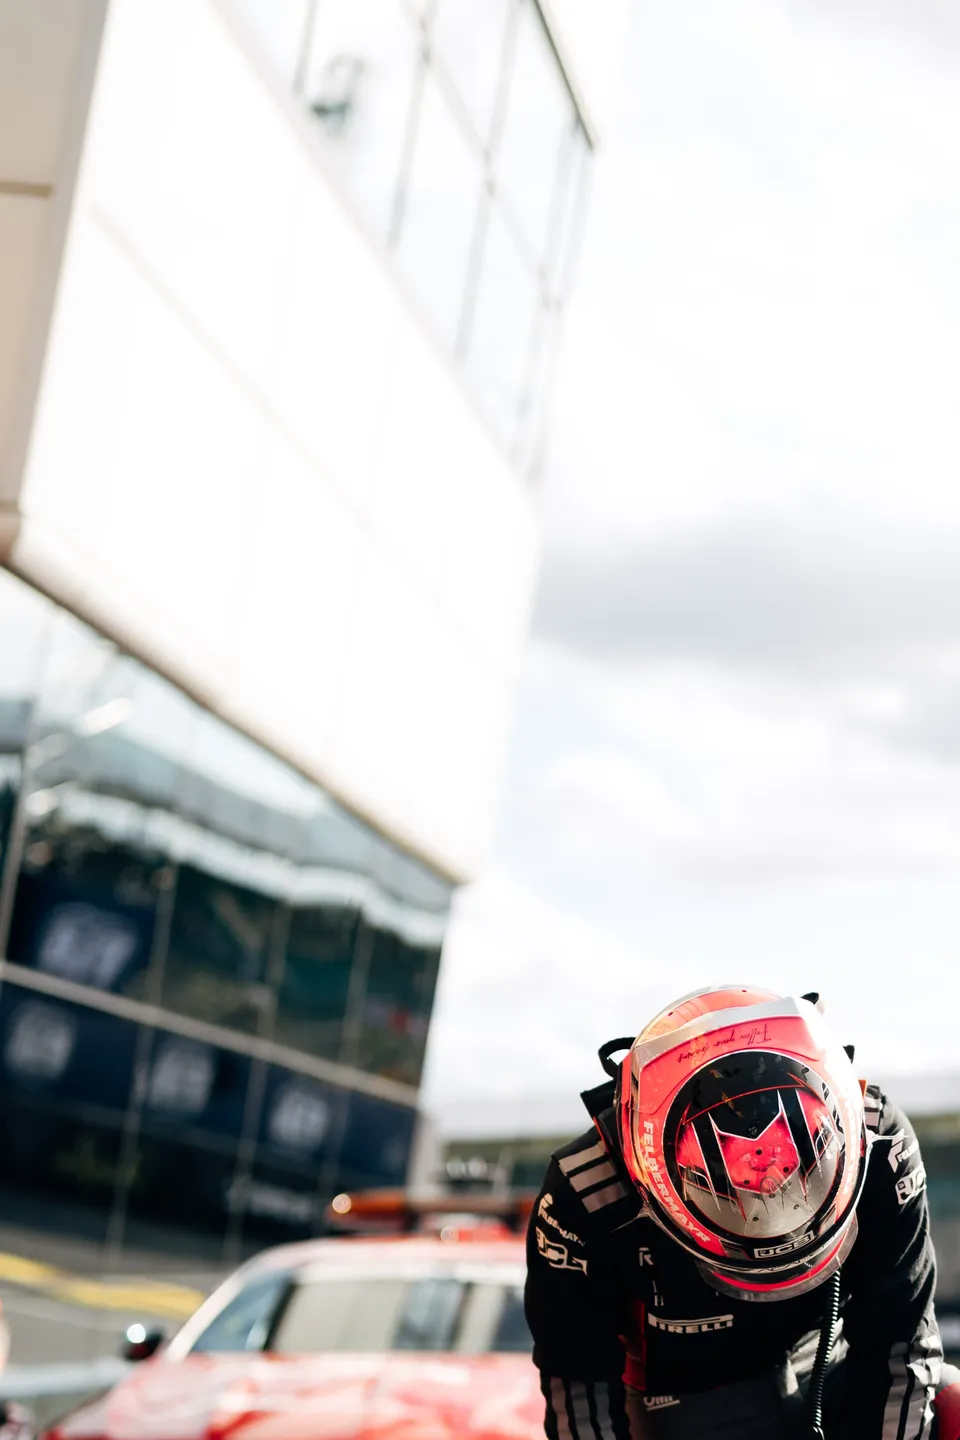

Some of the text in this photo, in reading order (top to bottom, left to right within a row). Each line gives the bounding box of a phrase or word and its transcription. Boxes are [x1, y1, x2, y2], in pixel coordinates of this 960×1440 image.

[640, 1120, 711, 1243] FELBERMAYR
[756, 1232, 813, 1258] JCB
[647, 1312, 734, 1335] PIRELLI
